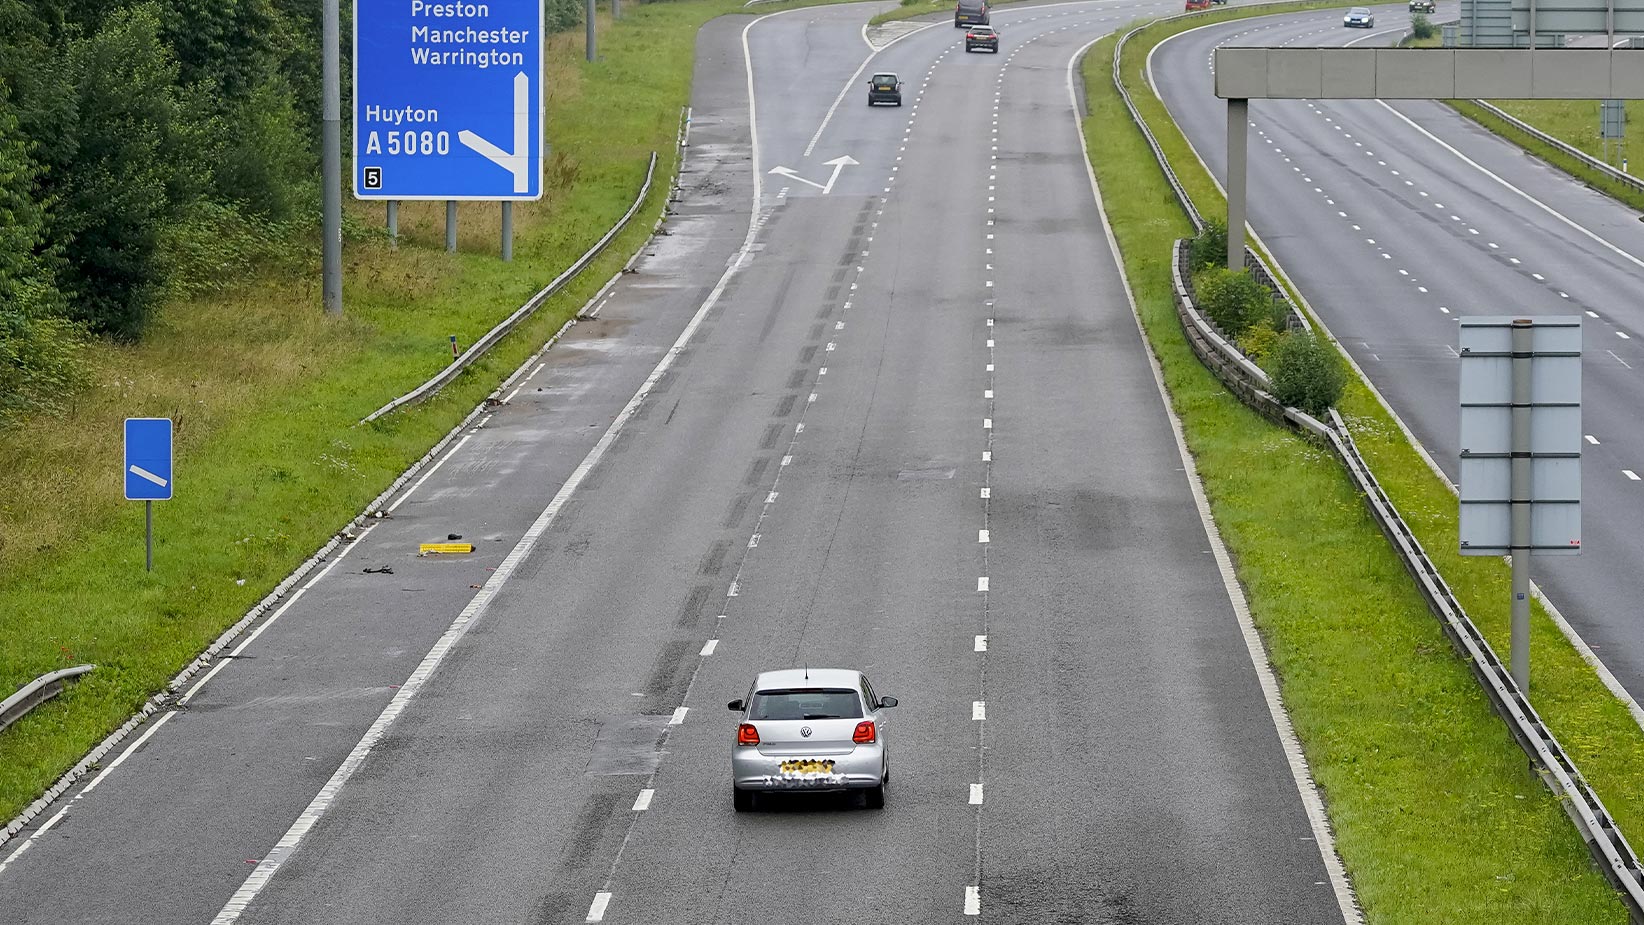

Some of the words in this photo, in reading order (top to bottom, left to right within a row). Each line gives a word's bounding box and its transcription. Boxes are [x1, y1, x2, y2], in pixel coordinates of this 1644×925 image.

[411, 0, 489, 17] Preston
[411, 26, 529, 43] Manchester
[411, 48, 523, 68] Warrington
[366, 105, 438, 125] Huyton
[368, 172, 378, 186] 5
